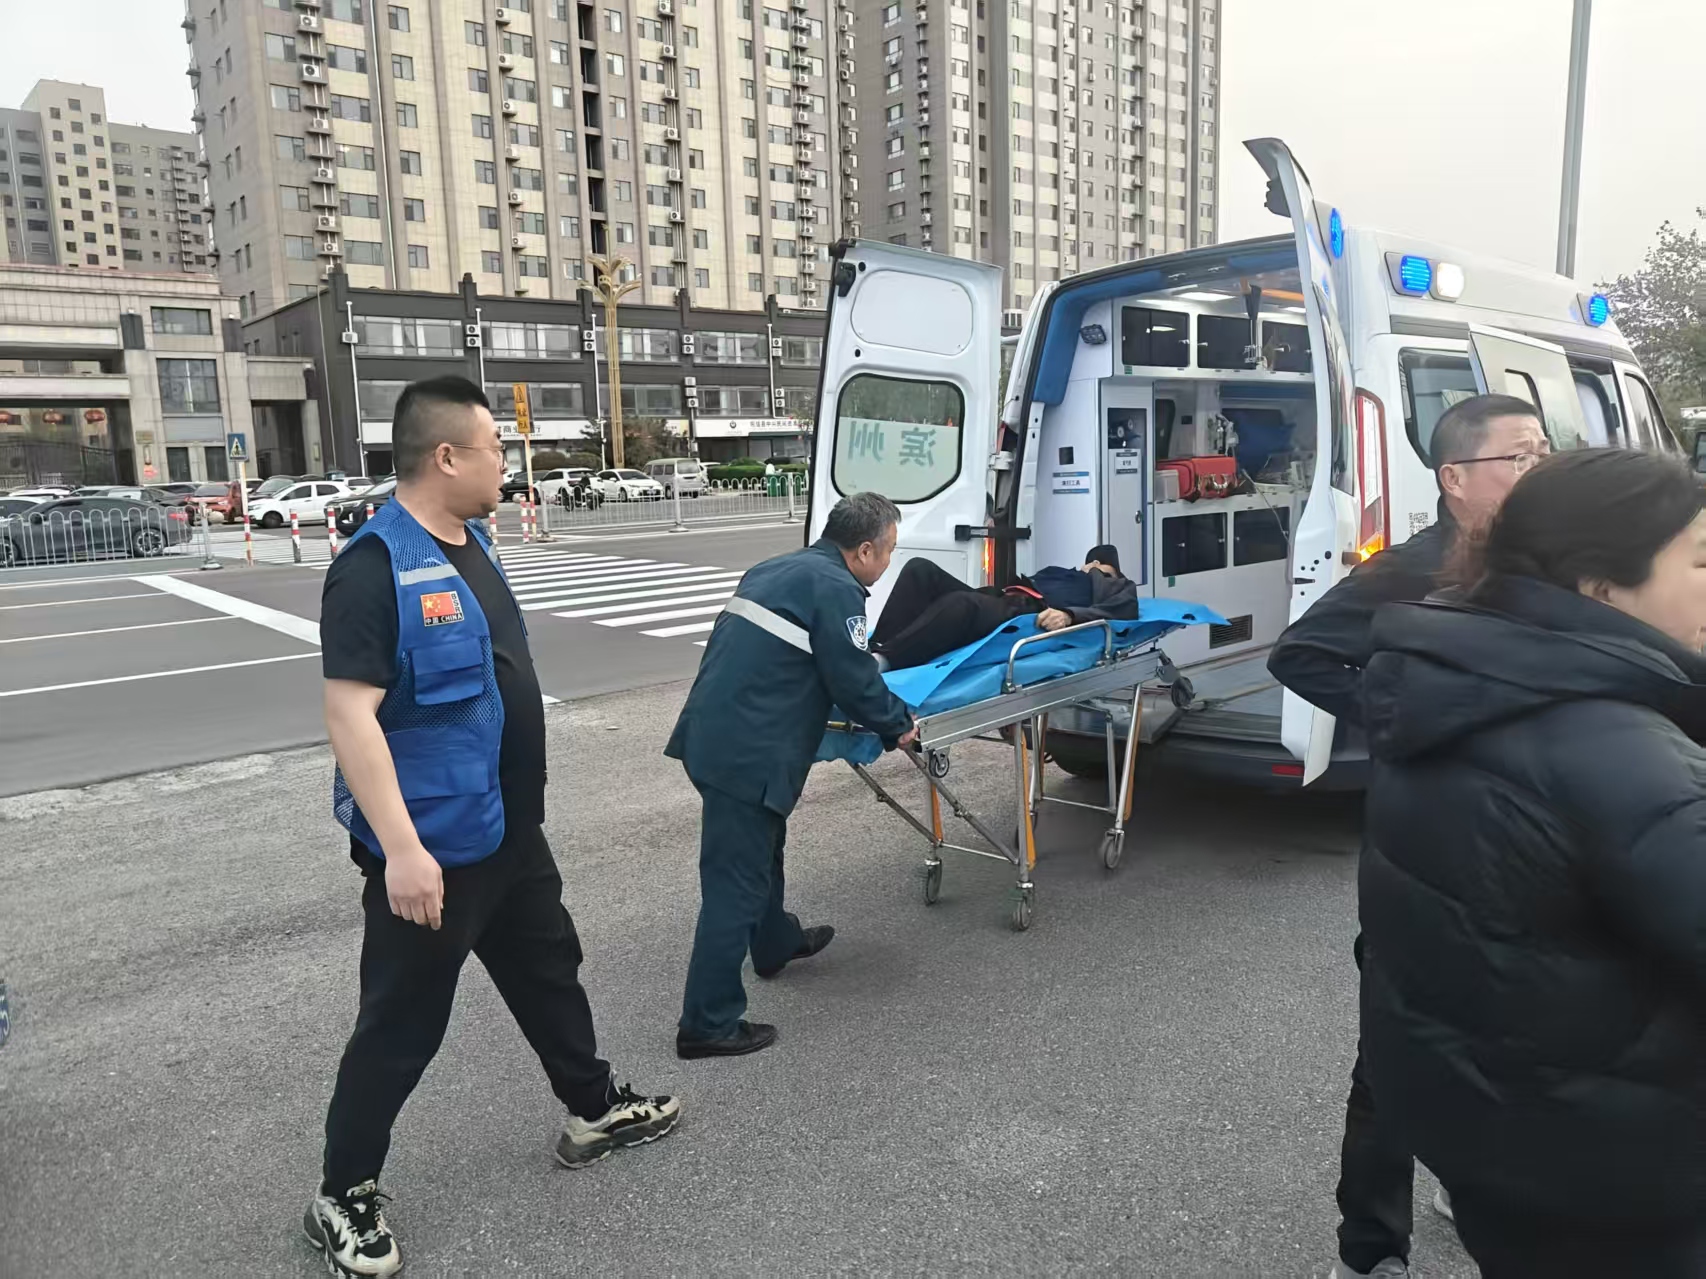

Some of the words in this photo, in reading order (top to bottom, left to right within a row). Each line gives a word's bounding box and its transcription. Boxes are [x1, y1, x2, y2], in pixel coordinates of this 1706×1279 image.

[518, 420, 528, 429] 行人
[451, 593, 461, 613] BSR
[425, 616, 439, 625] 中国
[440, 613, 463, 623] CHINA
